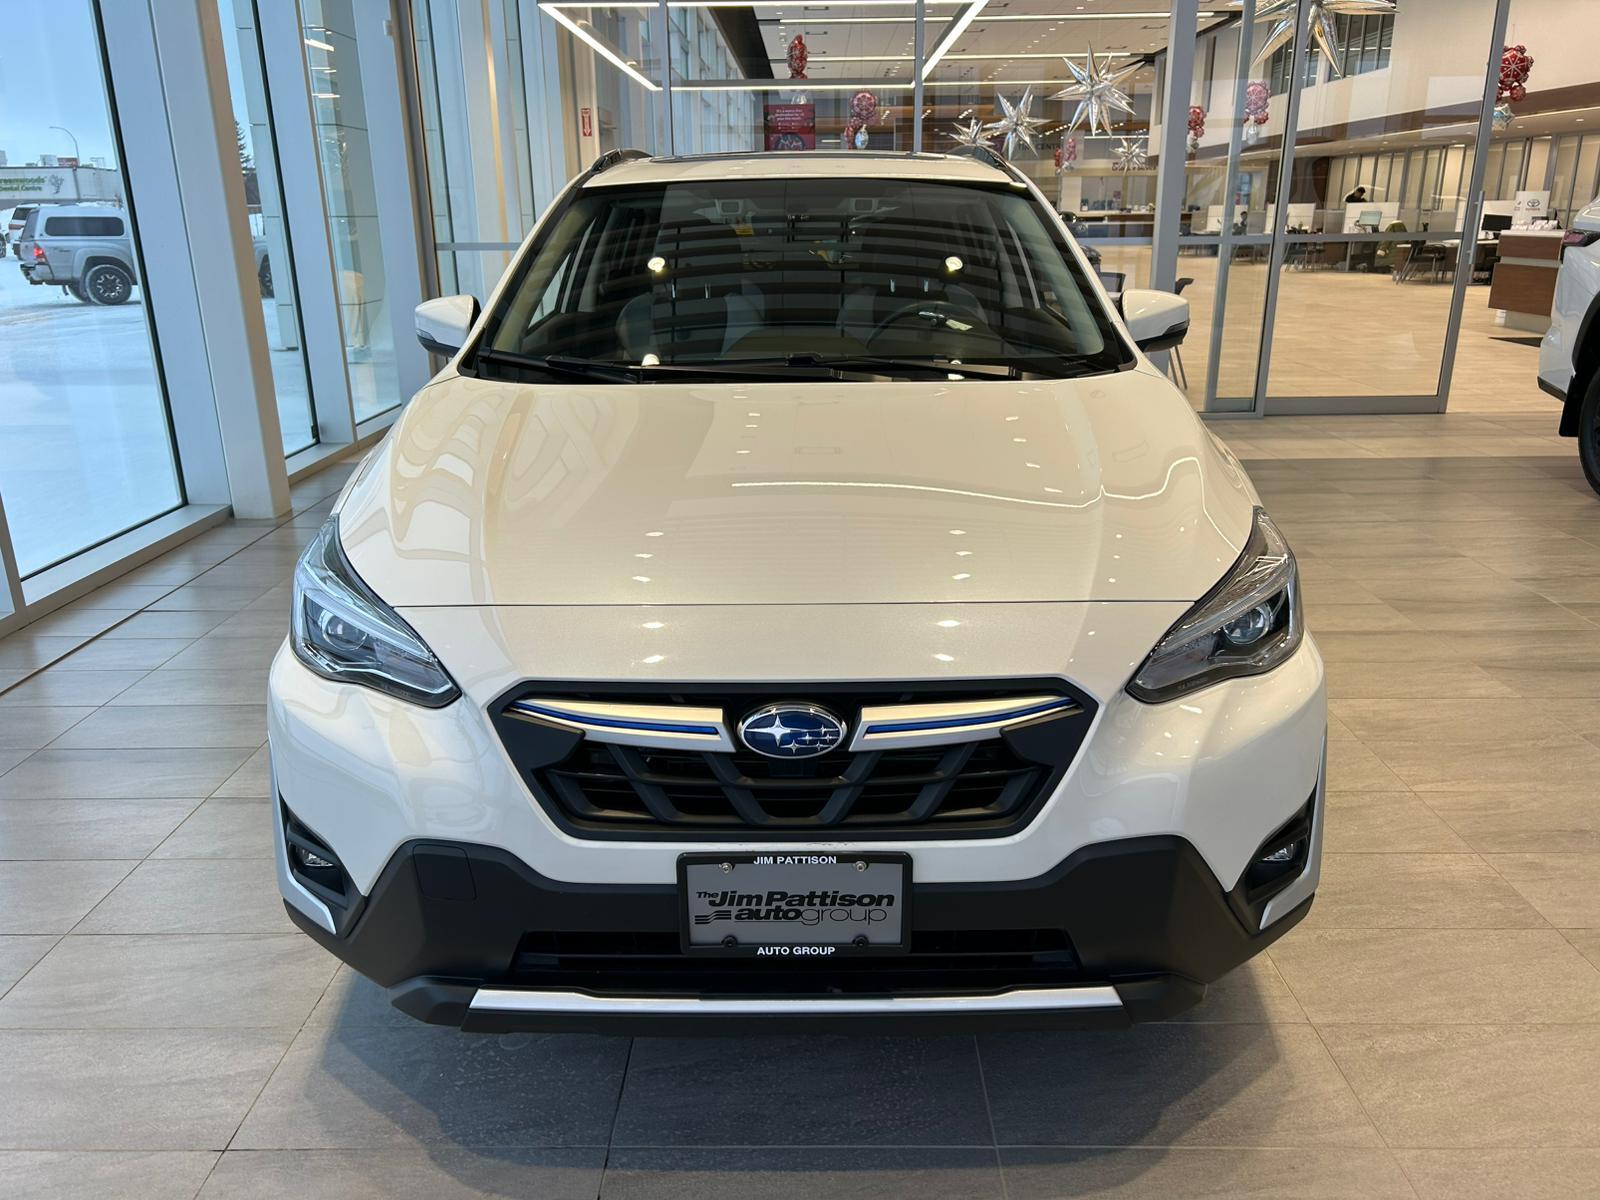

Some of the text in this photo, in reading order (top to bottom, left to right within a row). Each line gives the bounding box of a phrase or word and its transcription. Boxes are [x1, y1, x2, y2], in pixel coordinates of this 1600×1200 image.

[753, 856, 837, 865] JIM PATTISON
[695, 890, 895, 907] The Jim Pattison
[757, 946, 836, 956] AUTO GROUP
